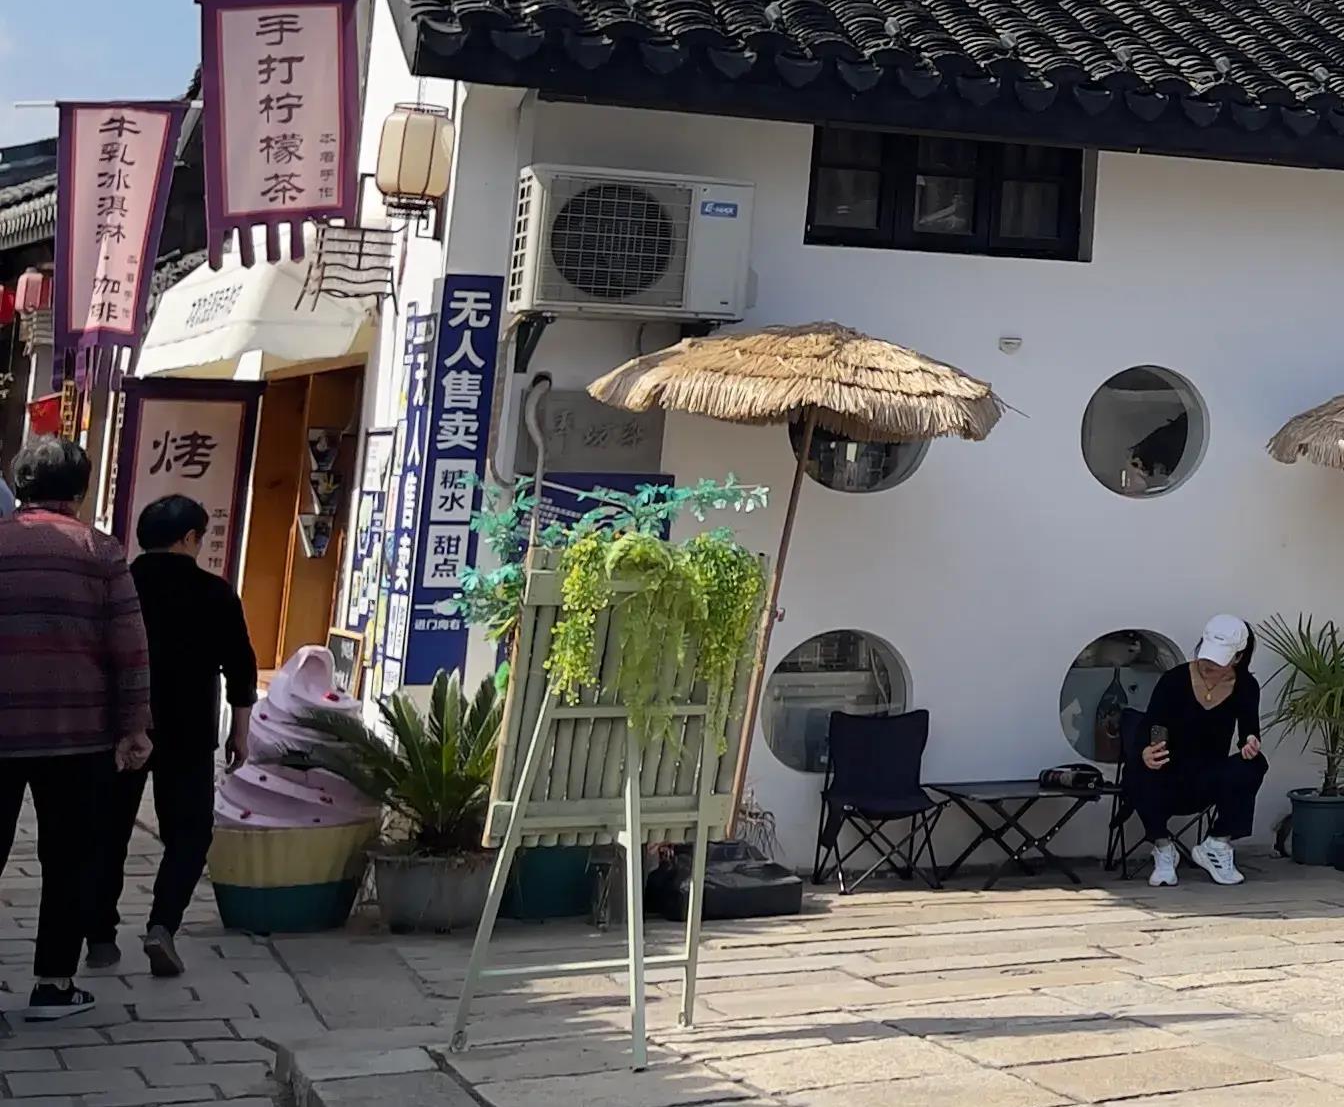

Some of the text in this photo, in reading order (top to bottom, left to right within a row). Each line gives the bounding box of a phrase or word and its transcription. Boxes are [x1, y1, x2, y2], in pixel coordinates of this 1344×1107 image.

[255, 13, 304, 205] 手打柠檬茶
[149, 430, 218, 506] 烤
[431, 290, 493, 579] 无人售卖 糖水 甜点
